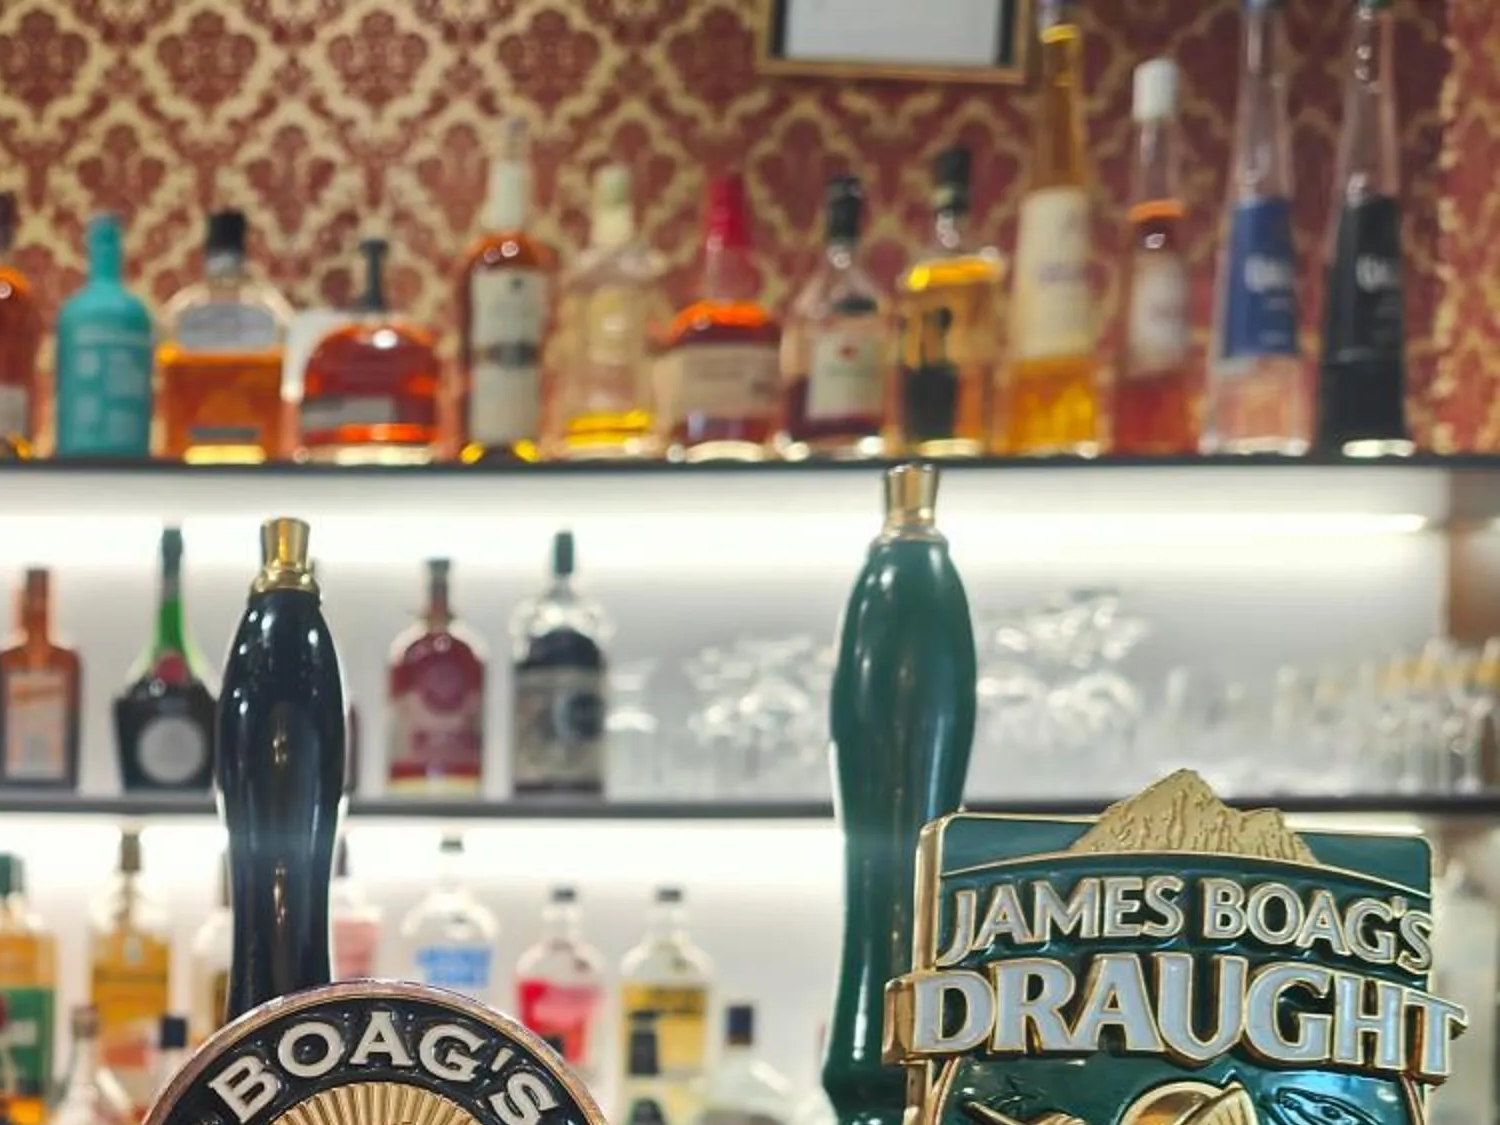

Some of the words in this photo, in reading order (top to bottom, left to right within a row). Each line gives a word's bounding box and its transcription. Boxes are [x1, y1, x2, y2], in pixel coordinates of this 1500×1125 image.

[934, 875, 1184, 968] JAMES
[1202, 877, 1434, 972] BOAG'S
[914, 952, 1467, 1079] DRAUGHT
